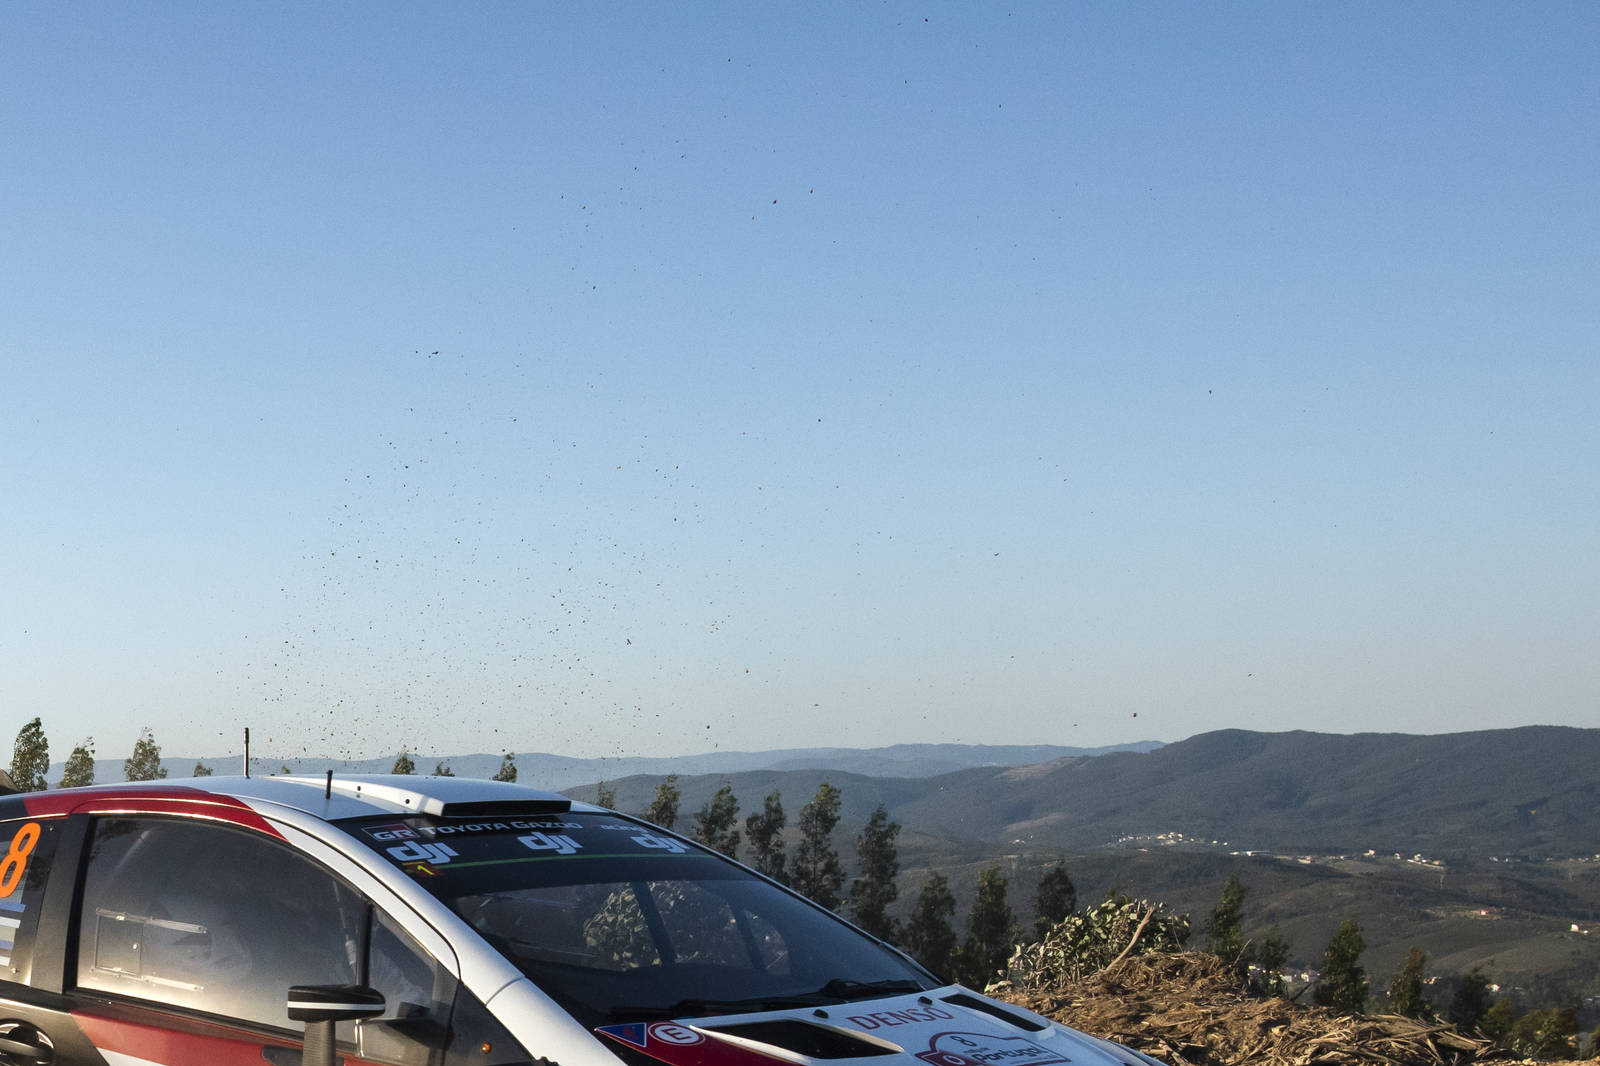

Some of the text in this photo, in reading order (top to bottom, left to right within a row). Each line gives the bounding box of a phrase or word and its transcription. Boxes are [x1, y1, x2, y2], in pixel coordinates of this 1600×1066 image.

[373, 829, 415, 841] GR
[418, 822, 508, 836] TOYOTA
[846, 1006, 954, 1031] DENSO
[661, 1027, 692, 1041] E
[950, 1035, 978, 1048] 8
